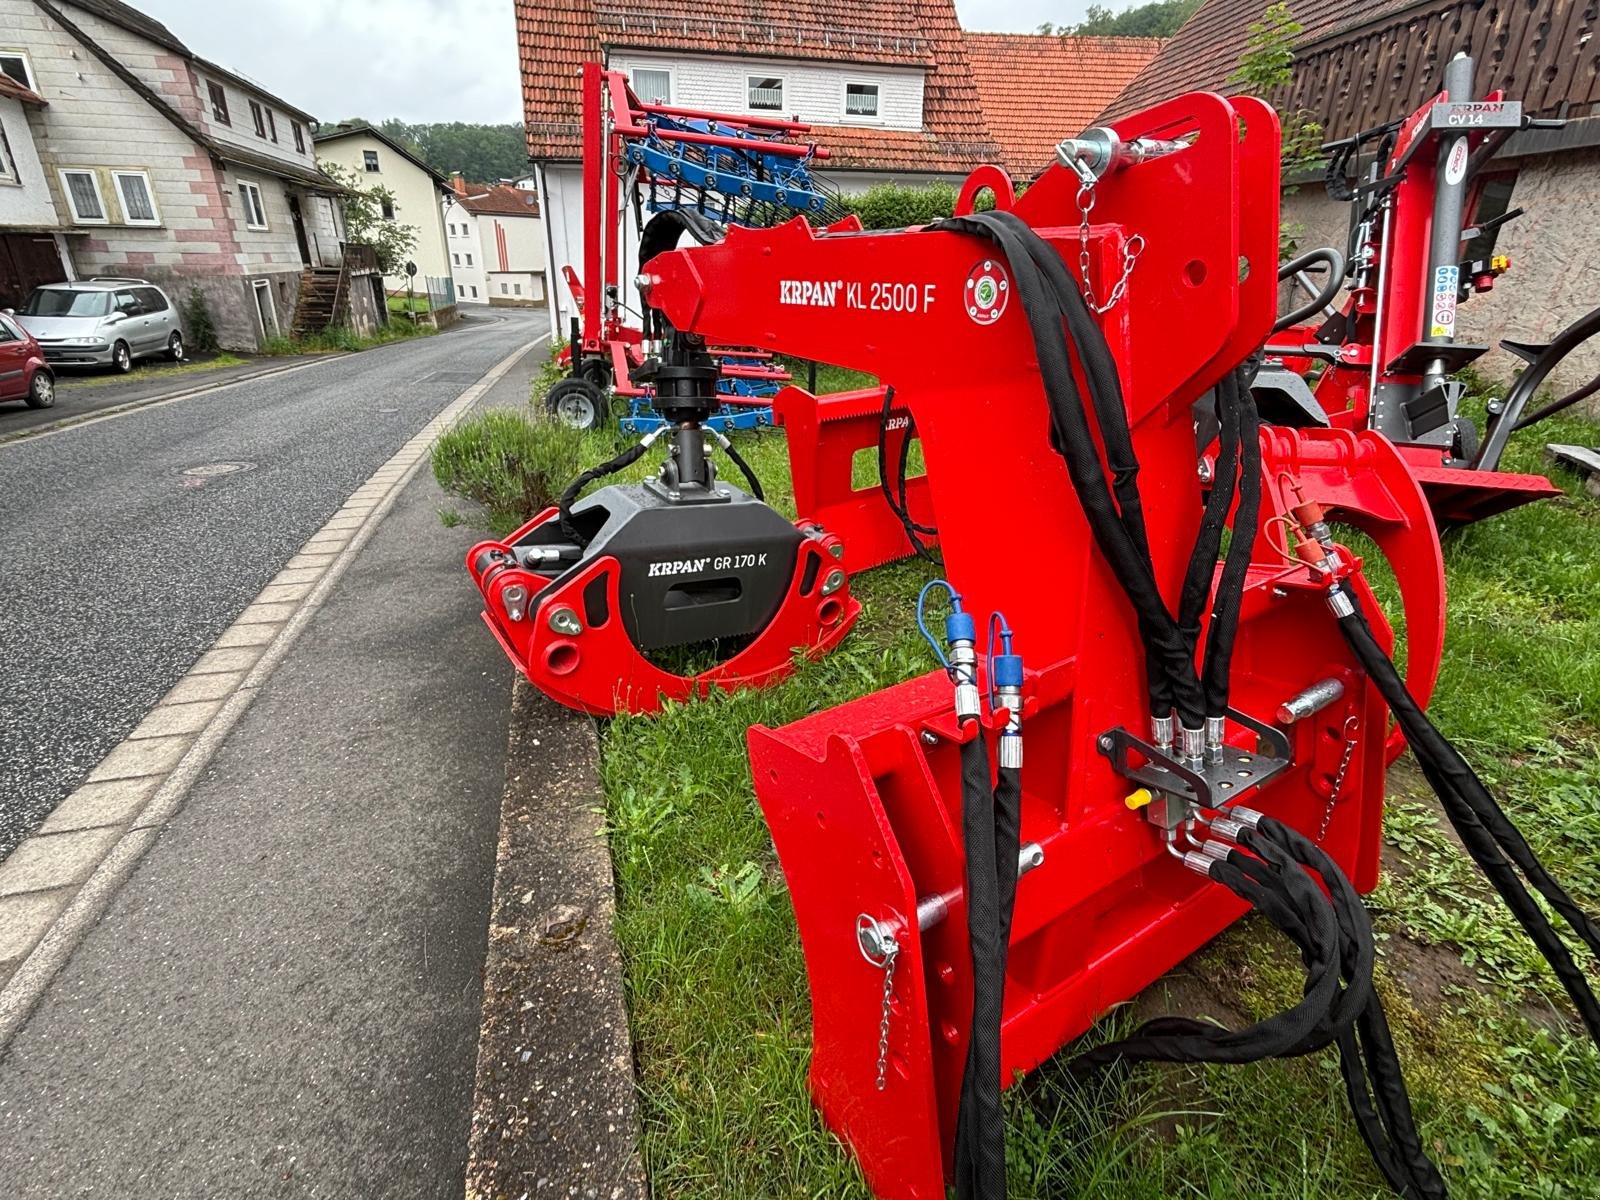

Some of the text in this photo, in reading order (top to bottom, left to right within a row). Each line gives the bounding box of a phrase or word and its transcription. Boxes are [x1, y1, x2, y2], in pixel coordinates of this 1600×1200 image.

[1448, 114, 1483, 125] CV 14
[780, 280, 936, 314] KRPAN KL 2500 F
[885, 416, 909, 431] RPA
[648, 553, 767, 577] KRPAN GR 170 K
